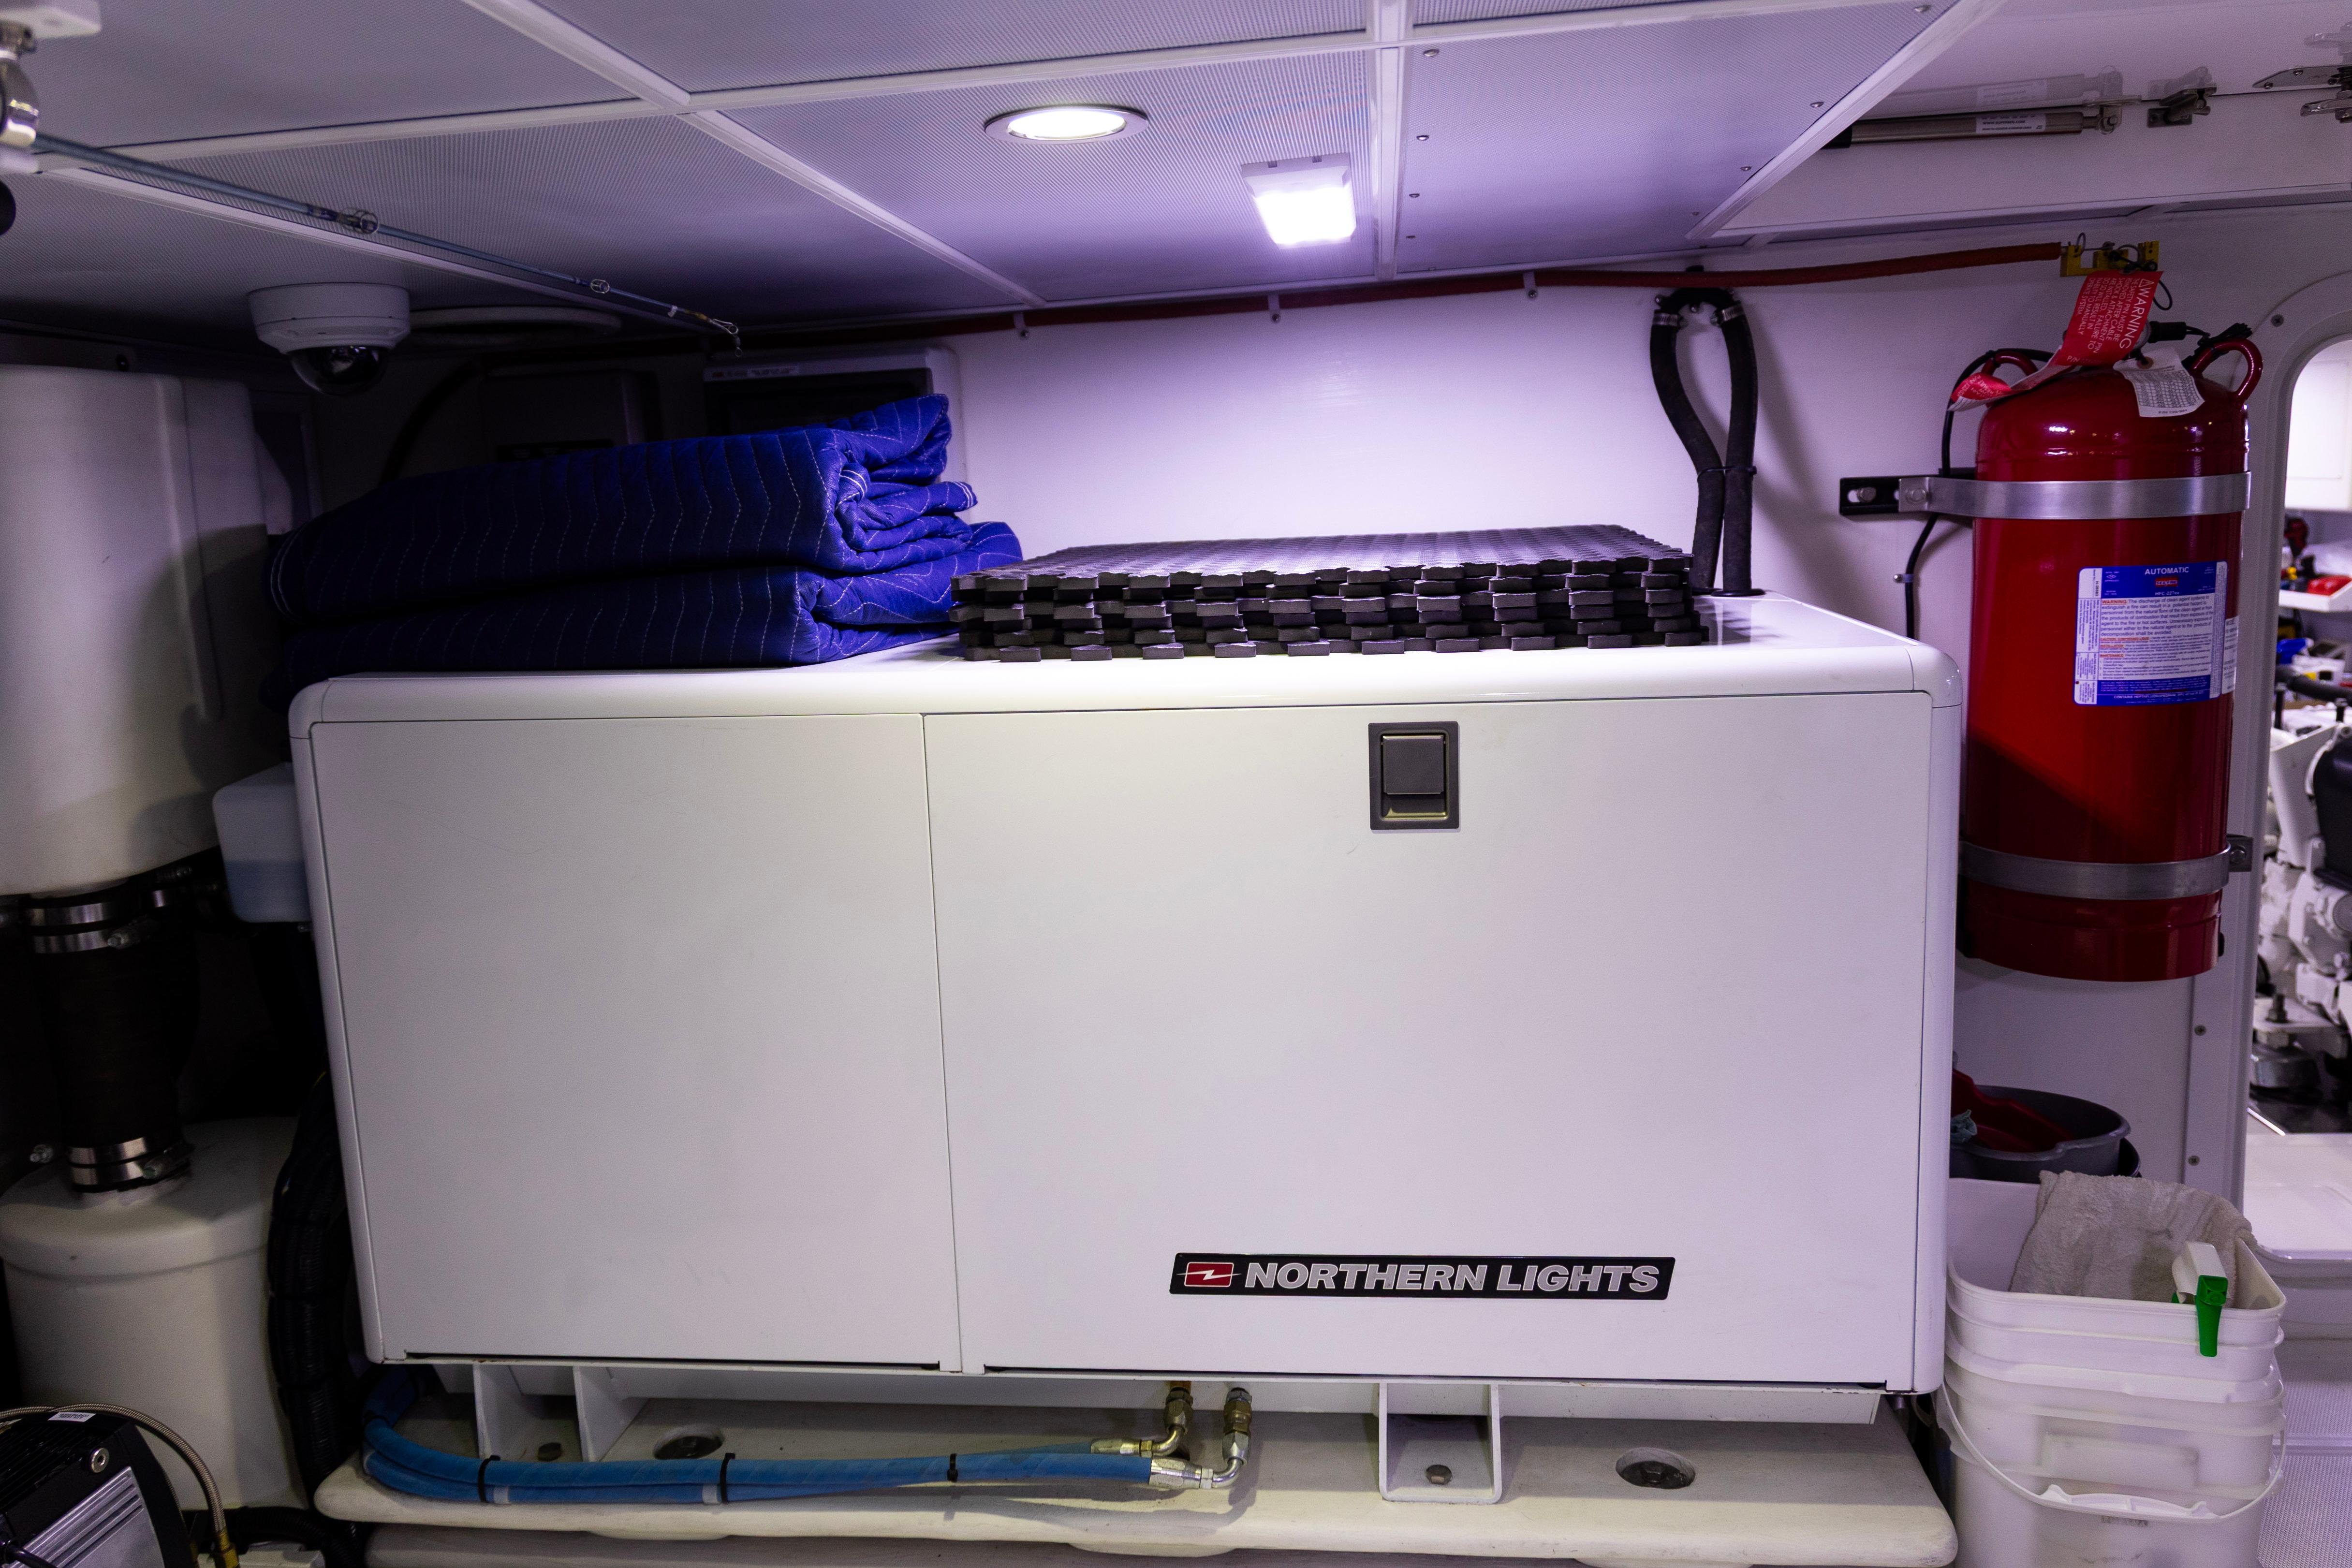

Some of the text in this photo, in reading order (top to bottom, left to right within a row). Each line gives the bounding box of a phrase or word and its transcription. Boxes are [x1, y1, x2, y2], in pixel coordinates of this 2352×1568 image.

[2083, 278, 2095, 294] OPERATE
[2114, 278, 2125, 294] SHOCK
[2126, 285, 2135, 302] SAFETY
[2095, 291, 2103, 302] WILL
[2089, 303, 2100, 322] RESULT
[2106, 278, 2131, 341] REMOVED AFTER CABLE
[2122, 303, 2131, 314] PIN
[2078, 304, 2092, 335] MANUALLY
[2100, 300, 2116, 341] ATTACHMENT
[2116, 315, 2127, 332] MUST
[2119, 287, 2151, 349] WARNING
[2091, 315, 2104, 339] FAILURE
[2087, 340, 2096, 350] TO
[2093, 342, 2102, 353] PIN
[2145, 567, 2190, 575] AUTOMATIC
[1245, 1262, 1659, 1292] NORTHERN LIGHTS
